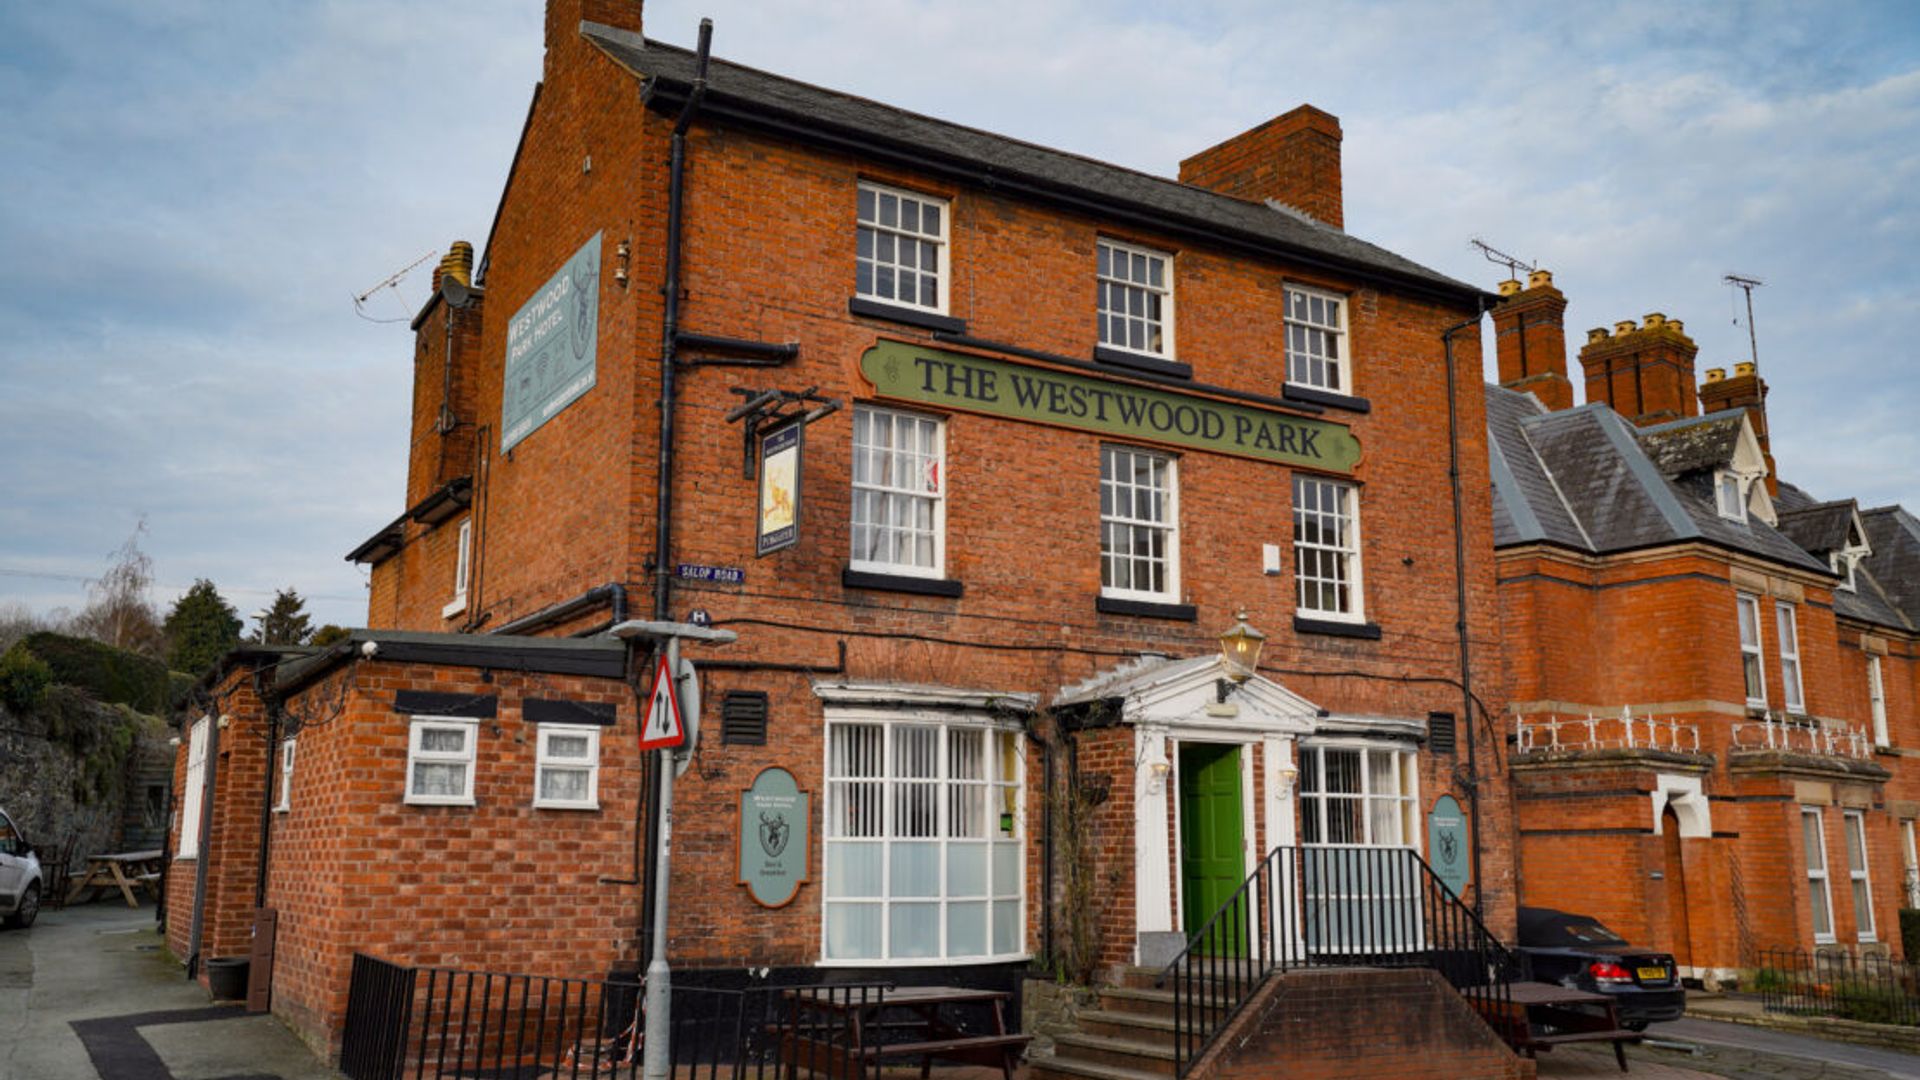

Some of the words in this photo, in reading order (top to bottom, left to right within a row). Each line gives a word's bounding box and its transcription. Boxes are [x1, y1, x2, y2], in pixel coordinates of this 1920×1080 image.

[508, 275, 569, 340] WESTWOOD
[511, 334, 532, 361] PARK
[534, 309, 563, 341] HOTEL
[915, 357, 998, 402] THE
[1011, 374, 1225, 441] WESTWOOD
[1233, 414, 1321, 458] PARK
[682, 566, 710, 578] SALOP
[715, 569, 738, 581] ROAD
[693, 612, 706, 622] H
